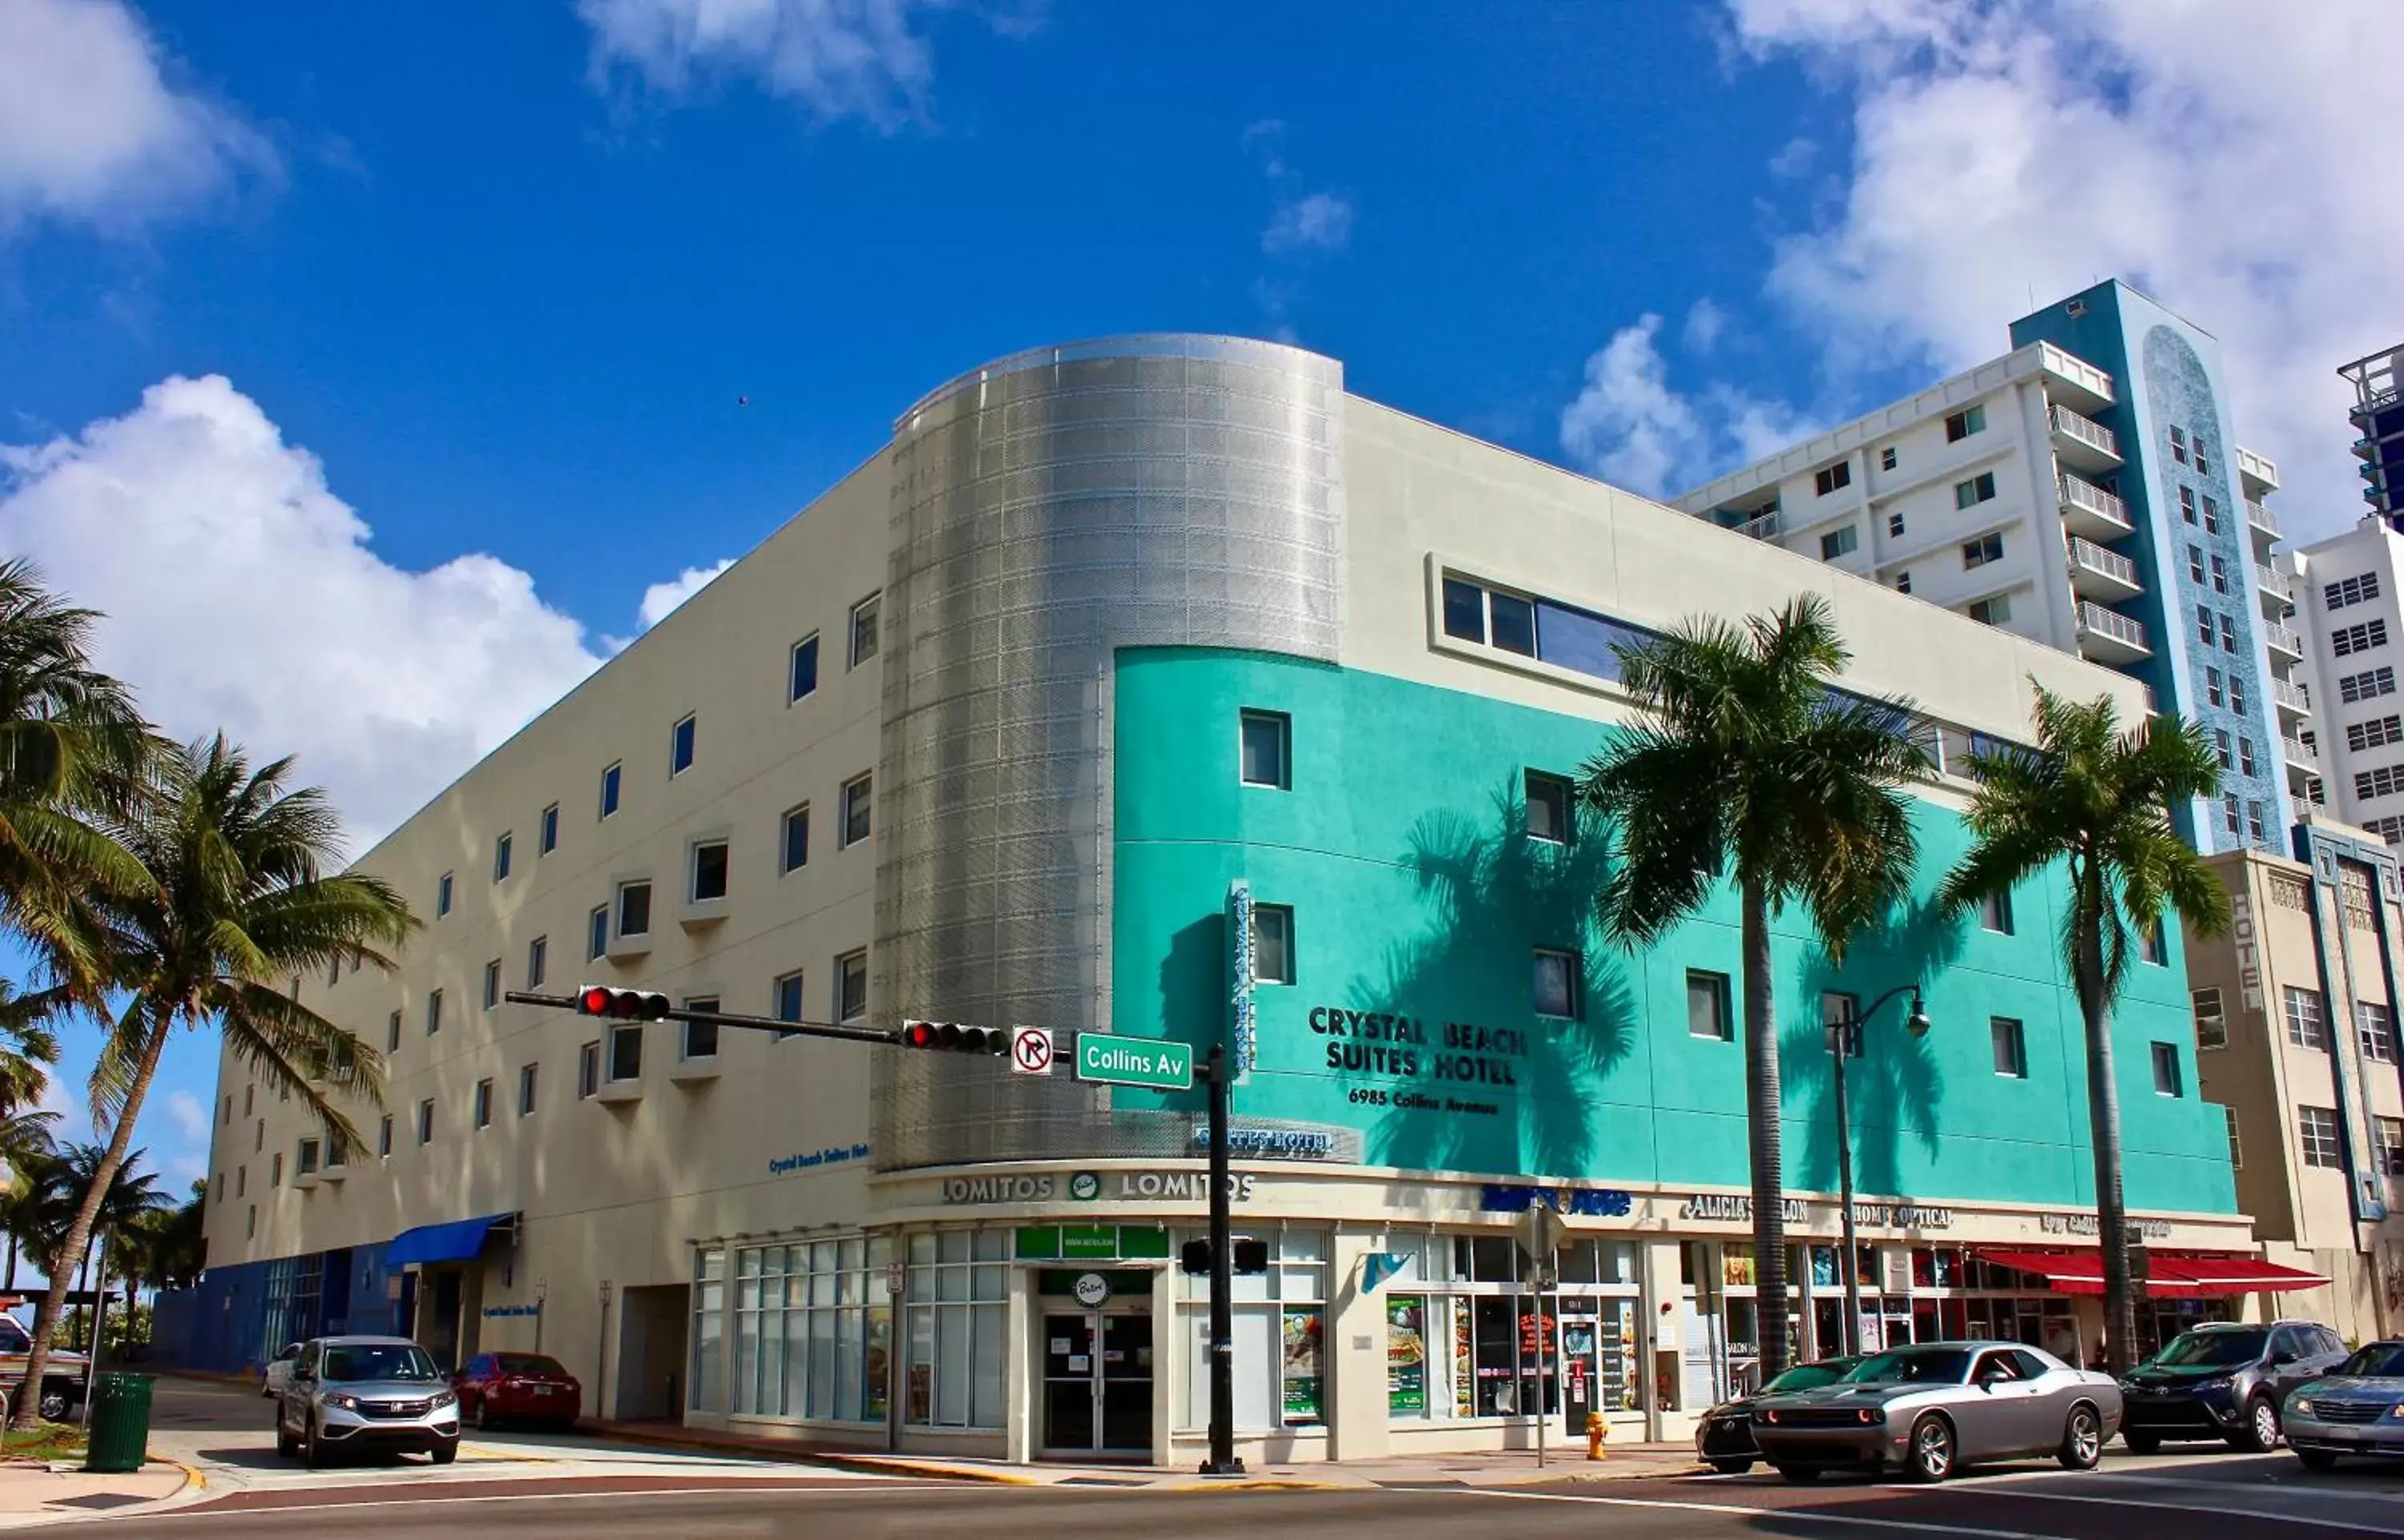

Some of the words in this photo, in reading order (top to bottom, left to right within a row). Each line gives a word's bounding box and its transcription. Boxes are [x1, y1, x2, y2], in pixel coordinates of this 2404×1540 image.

[2233, 894, 2263, 1011] HOTEL
[1309, 1007, 1427, 1045] CRYSTAL
[1444, 1022, 1527, 1056] BEACH
[1087, 1046, 1151, 1073] Collins
[1156, 1054, 1183, 1075] Av
[1326, 1042, 1417, 1076] SUITES
[1434, 1053, 1516, 1086] HOTEL
[1349, 1088, 1387, 1107] 6985
[1393, 1092, 1439, 1110] Collins
[1446, 1097, 1498, 1115] Avenue
[1198, 1127, 1269, 1147] SITES
[942, 1176, 1053, 1201] LOMITOS
[1899, 1207, 1954, 1226] OPTICAL
